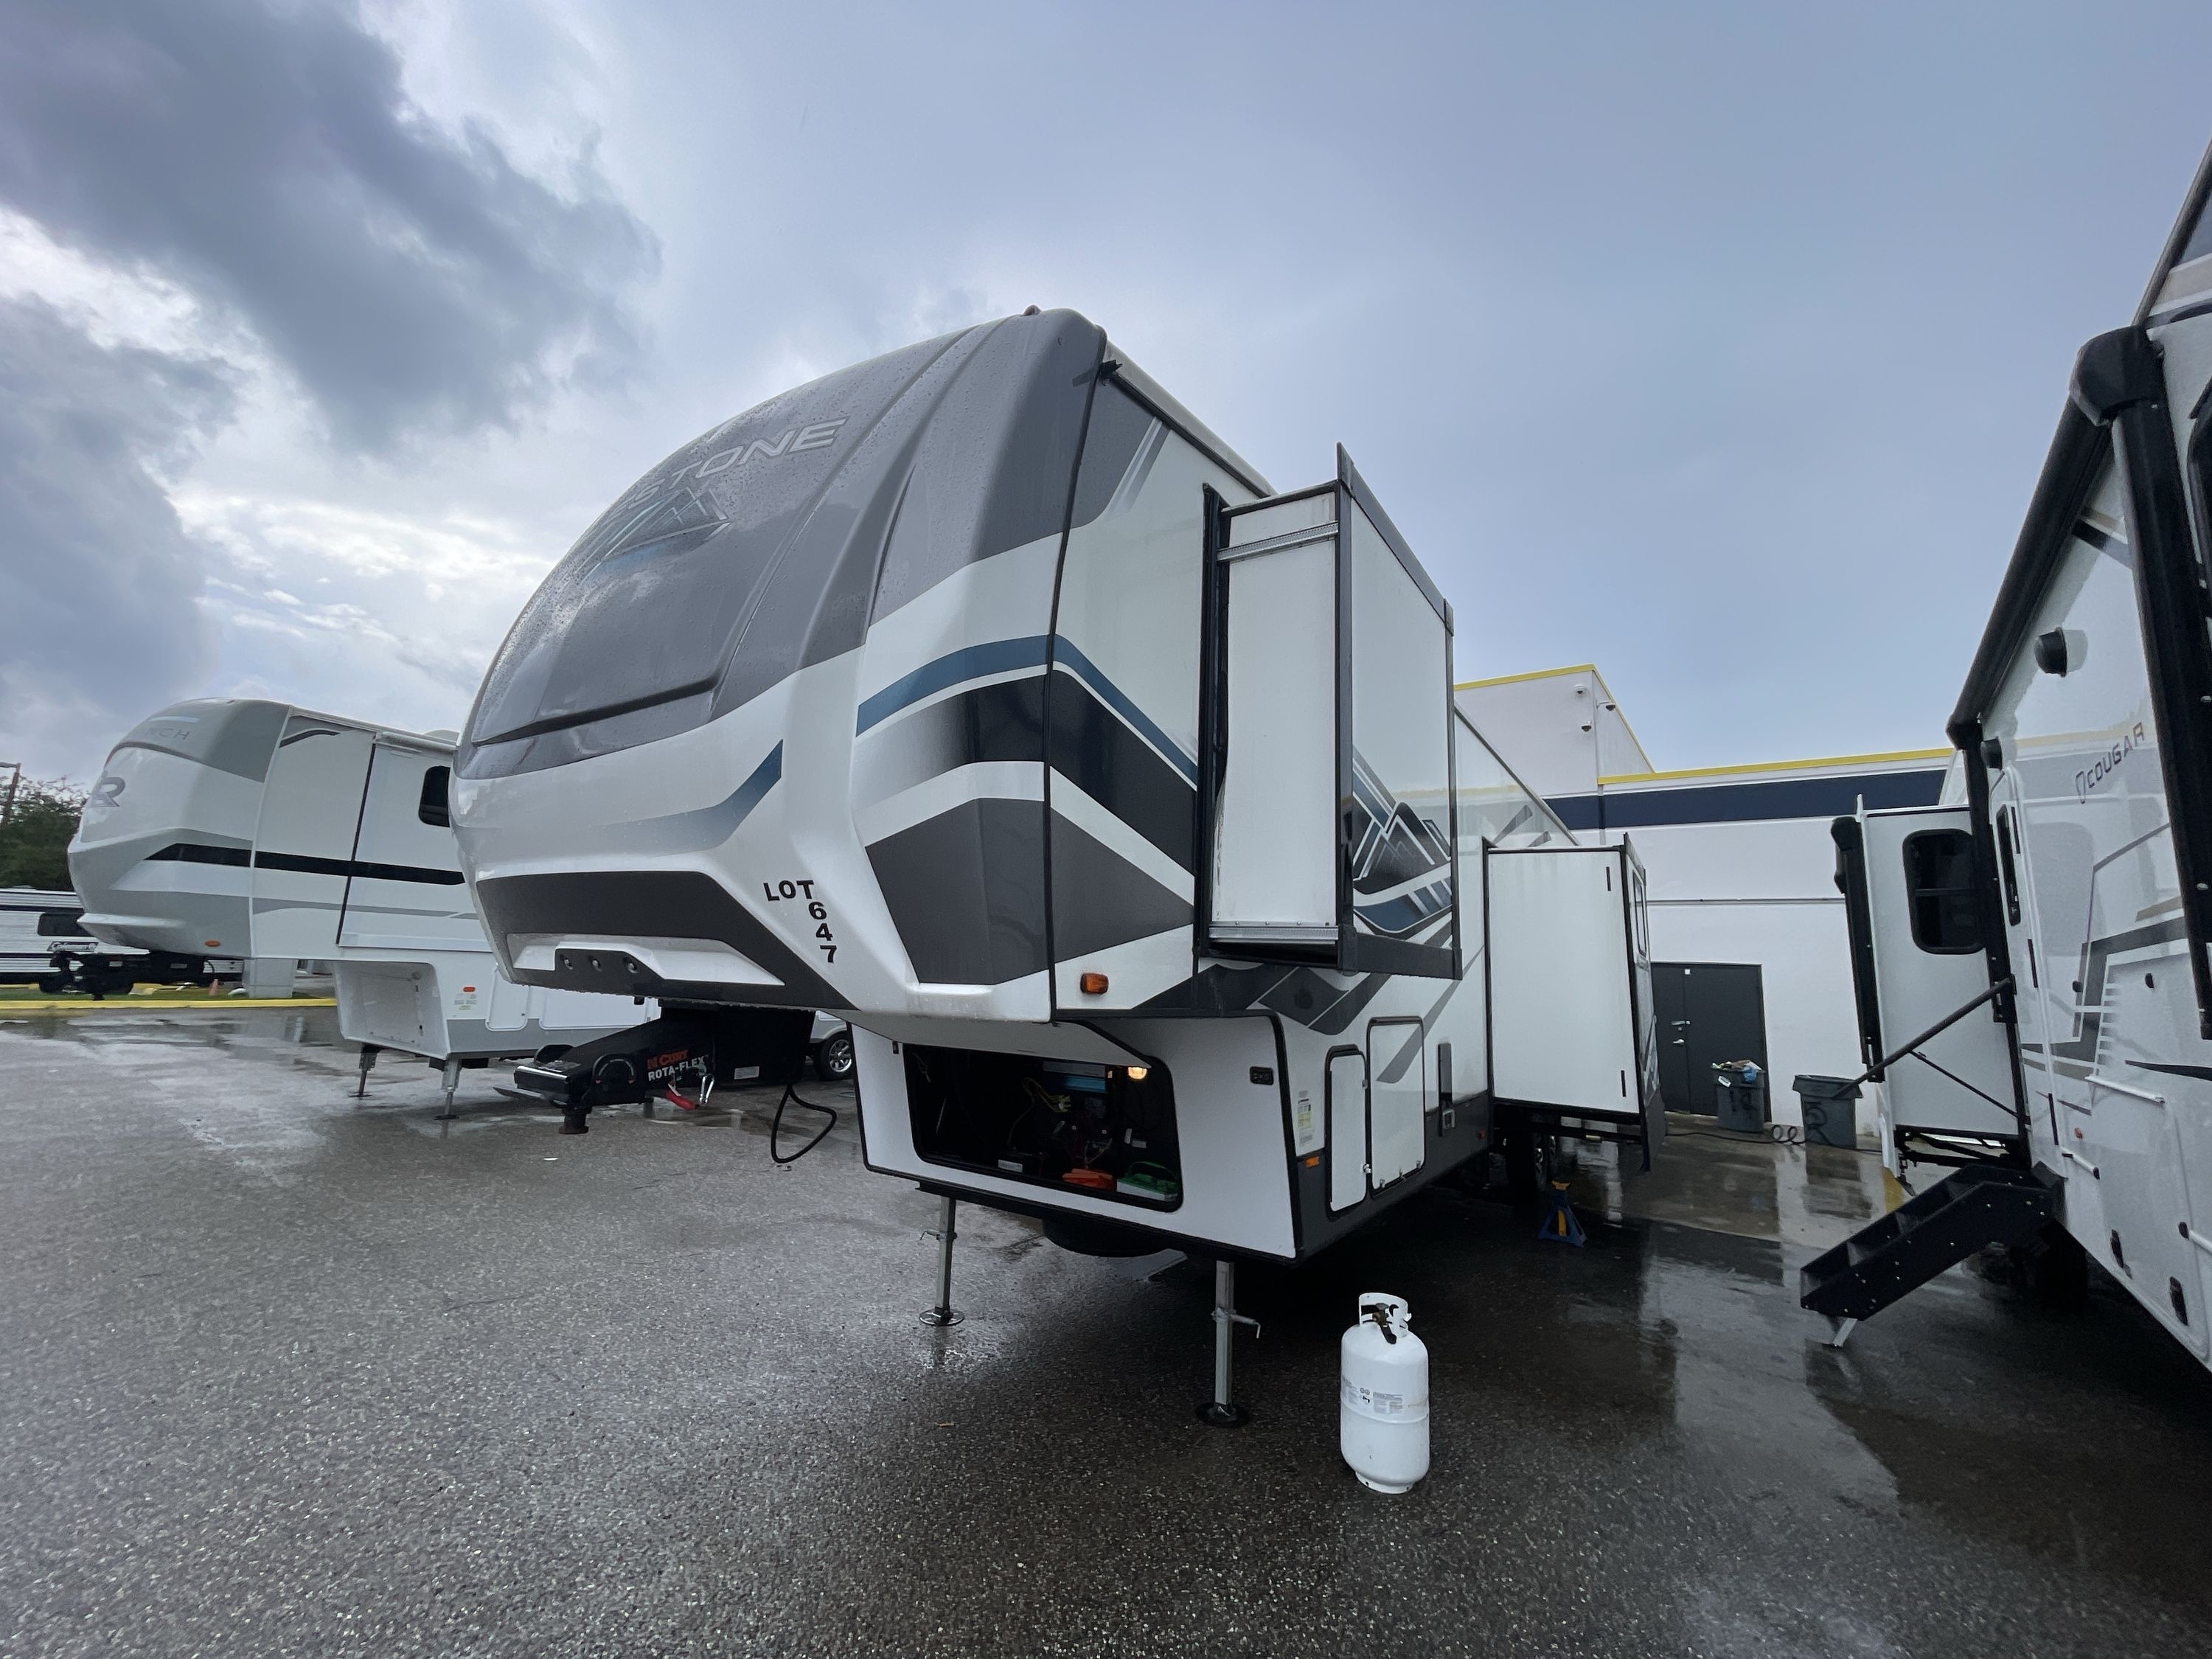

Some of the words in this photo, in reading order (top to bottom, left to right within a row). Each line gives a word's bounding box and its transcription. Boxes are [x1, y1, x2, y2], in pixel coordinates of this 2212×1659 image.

[2087, 721, 2145, 789] COUGAR
[763, 880, 814, 901] LOT
[647, 1057, 704, 1082] ROTA-FLEX
